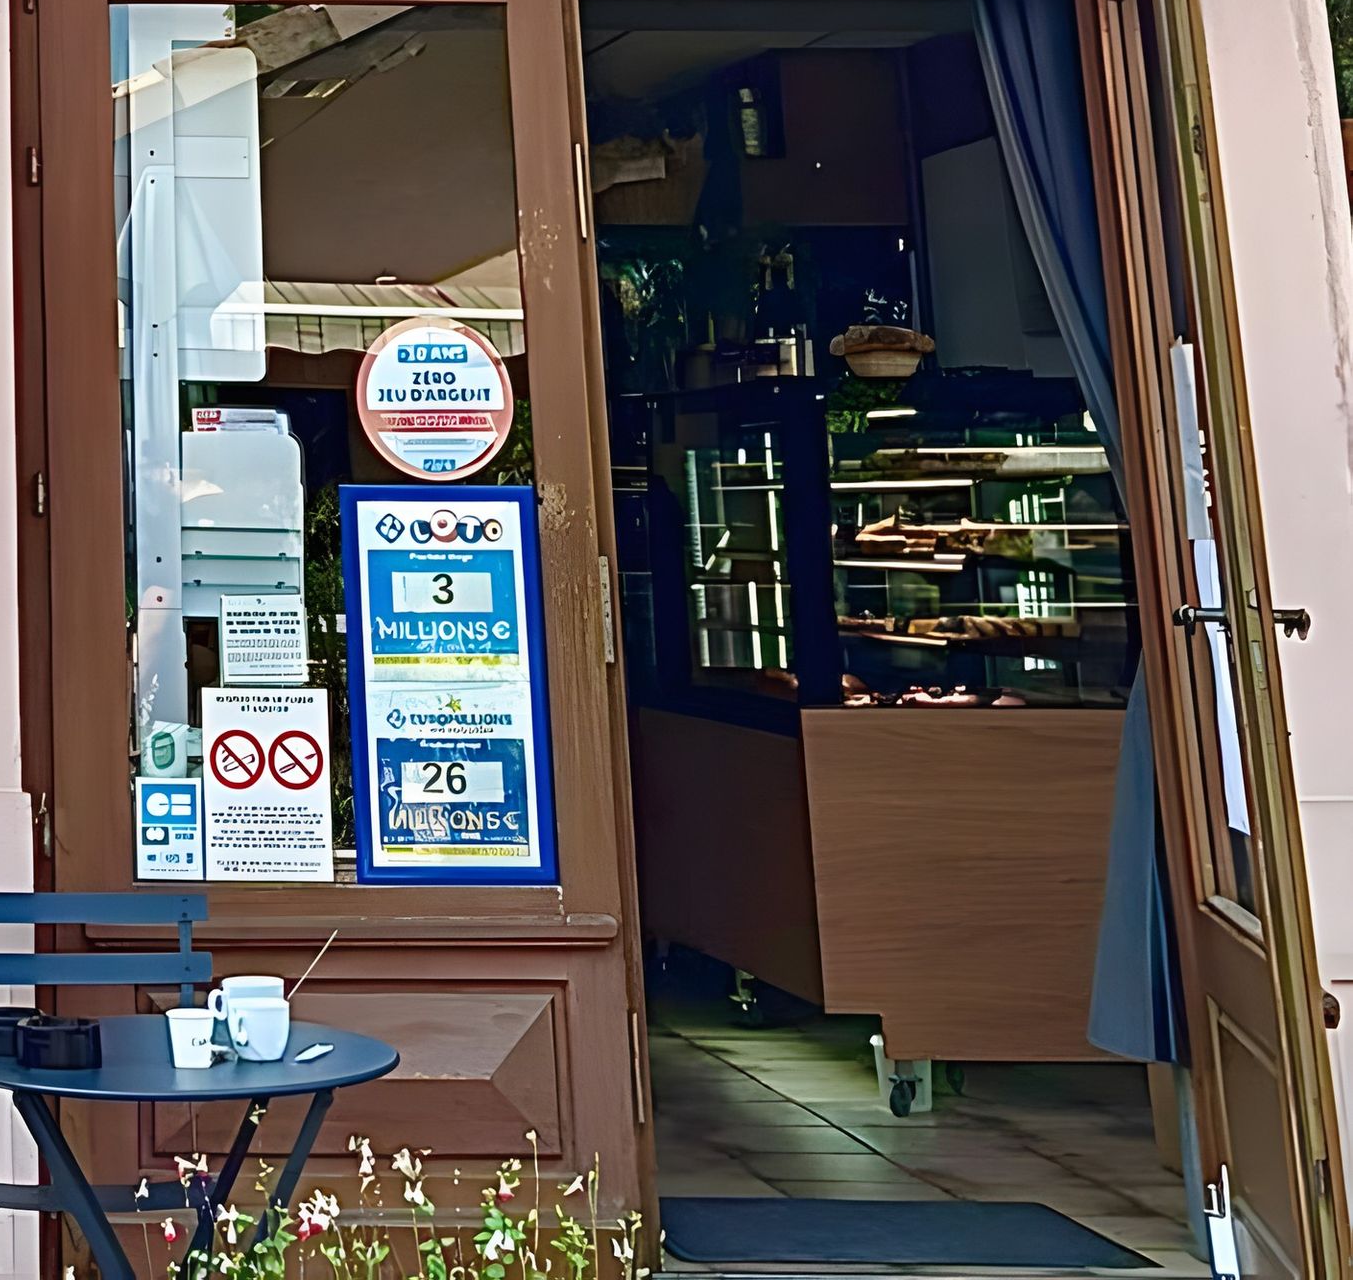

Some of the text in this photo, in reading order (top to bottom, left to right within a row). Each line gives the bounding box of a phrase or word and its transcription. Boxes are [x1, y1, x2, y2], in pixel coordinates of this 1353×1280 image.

[410, 509, 503, 544] LOTO
[432, 573, 455, 605] 3
[422, 762, 467, 795] 26
